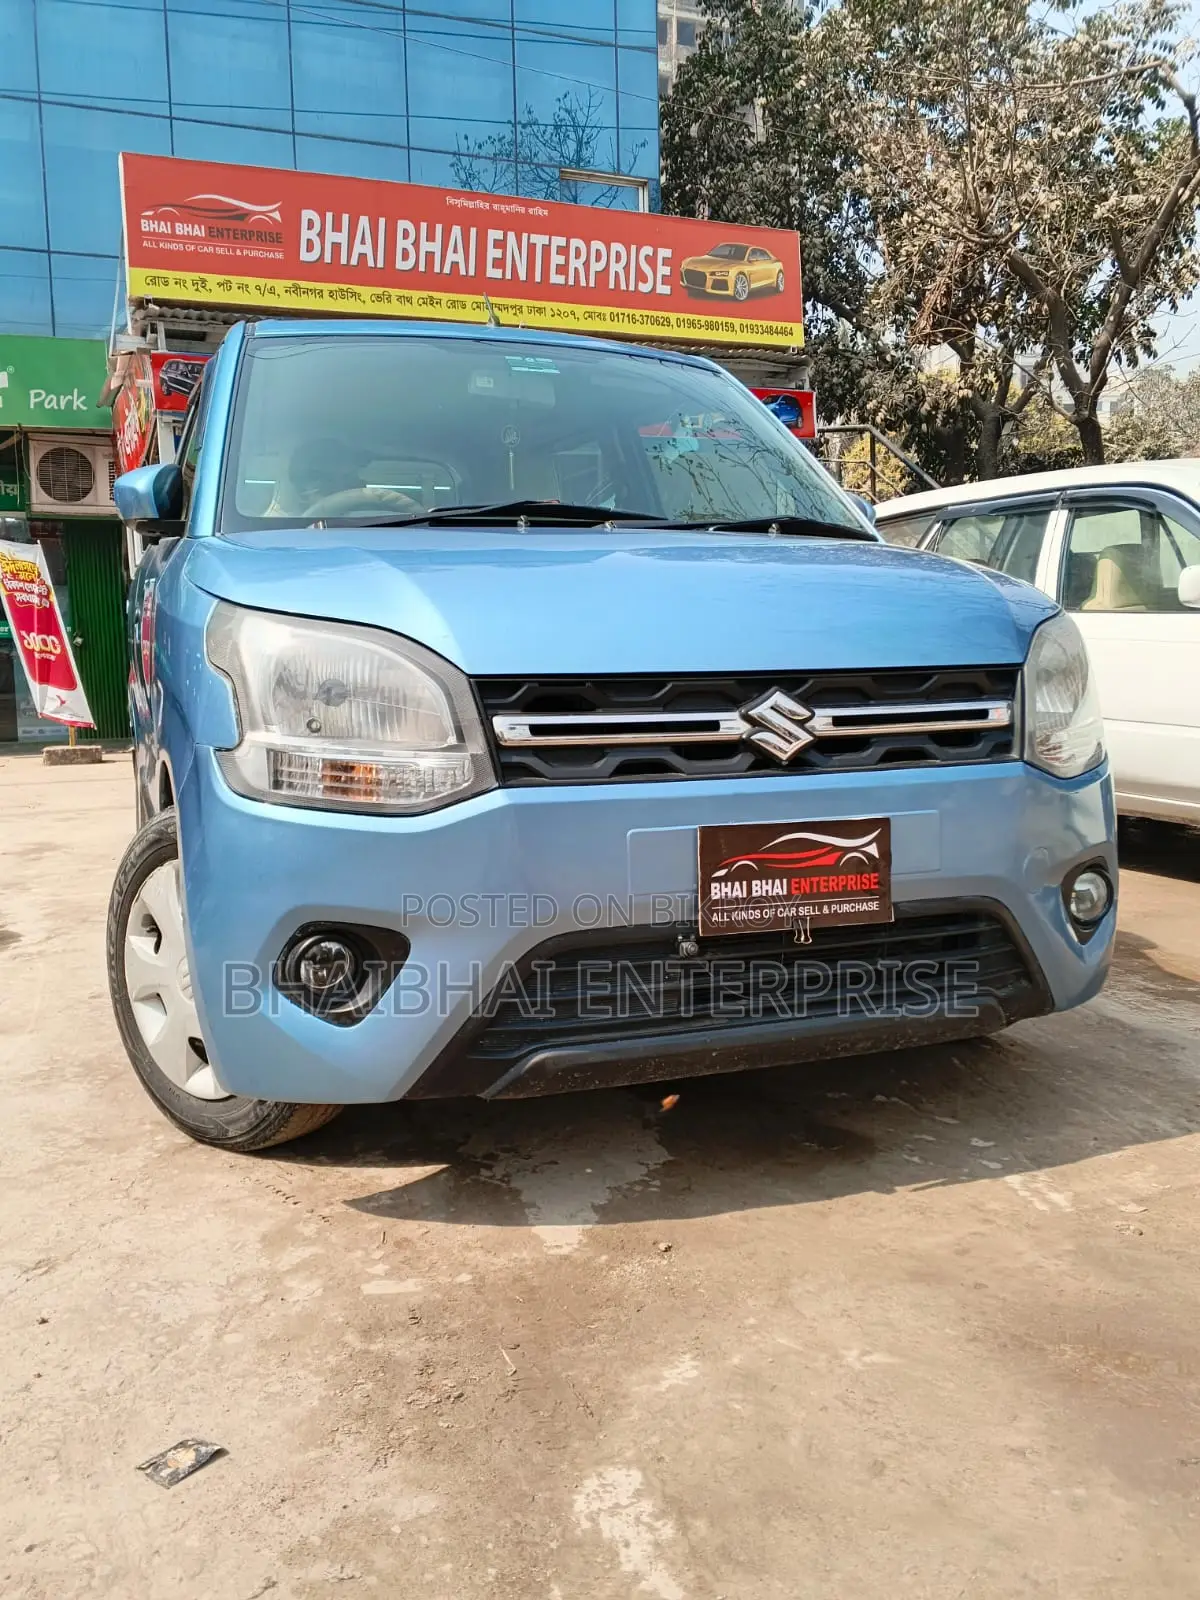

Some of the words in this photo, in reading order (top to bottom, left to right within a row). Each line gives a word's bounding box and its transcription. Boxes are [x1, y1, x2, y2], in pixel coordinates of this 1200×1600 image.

[140, 218, 171, 234] BHAI
[175, 222, 205, 238] BHAI
[208, 226, 283, 244] ENTERPRISE
[142, 240, 158, 249] ALL
[160, 241, 184, 251] KINDS
[185, 244, 196, 252] OF
[197, 245, 214, 254] CAR
[216, 247, 234, 256] SELL
[244, 250, 284, 260] PURCHASE
[300, 209, 386, 269] BHAI
[395, 218, 478, 278] BHAI
[486, 228, 672, 296] ENTERPRISE
[144, 275, 170, 287] রোড
[172, 280, 188, 290] নং
[236, 282, 252, 295] নং
[283, 282, 324, 300] নবীনগর
[328, 287, 366, 304] হাউসিং,
[416, 294, 443, 309] মেইন
[446, 299, 467, 310] রোড
[526, 304, 546, 318] ঢাকা
[610, 311, 674, 330] 01716-370629,
[676, 317, 738, 336] 01965-980159,
[740, 324, 794, 337] 01933484464
[29, 388, 88, 410] Park
[710, 880, 747, 900] BHAI
[751, 878, 788, 897] BHAI
[791, 872, 880, 895] ENTERPRISE
[712, 910, 730, 922] ALL
[732, 908, 760, 921] KINDS
[762, 908, 776, 918] OF
[777, 906, 797, 918] CAR
[798, 904, 820, 916] SELL
[822, 904, 830, 914] &
[831, 901, 880, 914] PURCHASE
